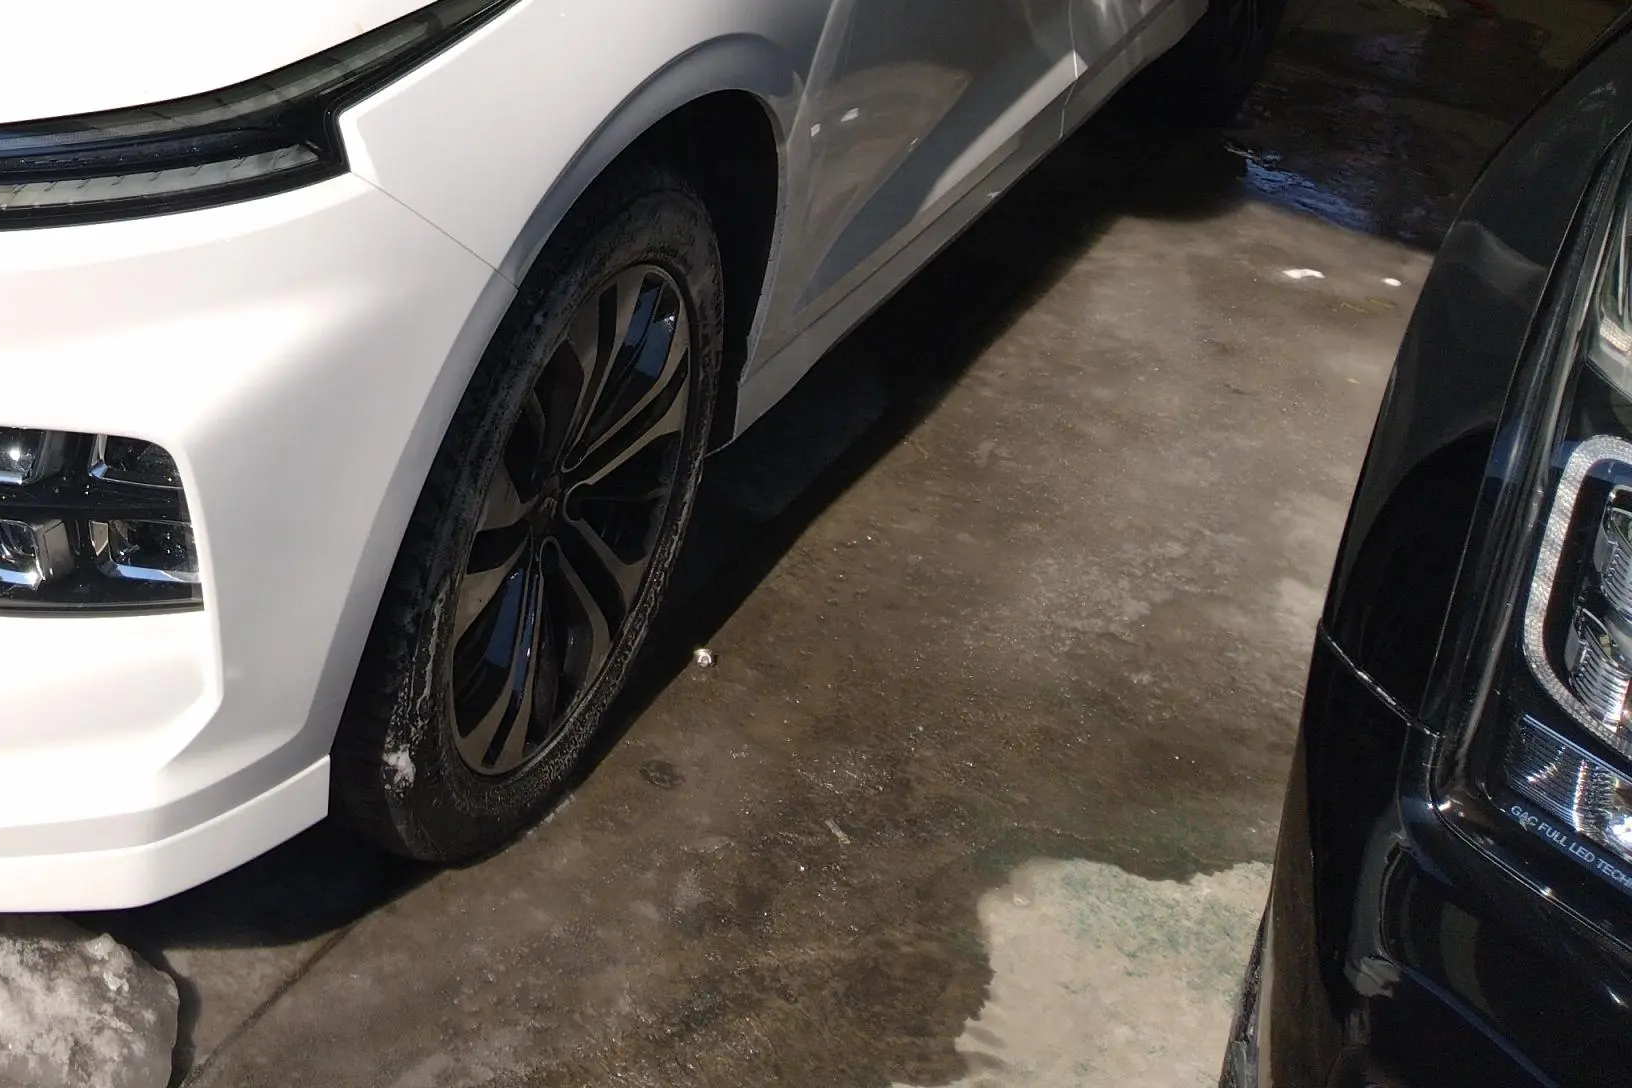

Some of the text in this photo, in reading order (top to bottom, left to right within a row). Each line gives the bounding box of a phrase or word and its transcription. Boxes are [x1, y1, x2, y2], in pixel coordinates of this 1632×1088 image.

[1510, 805, 1538, 827] GAC
[1537, 822, 1569, 847] FULL
[1568, 842, 1595, 863] LED
